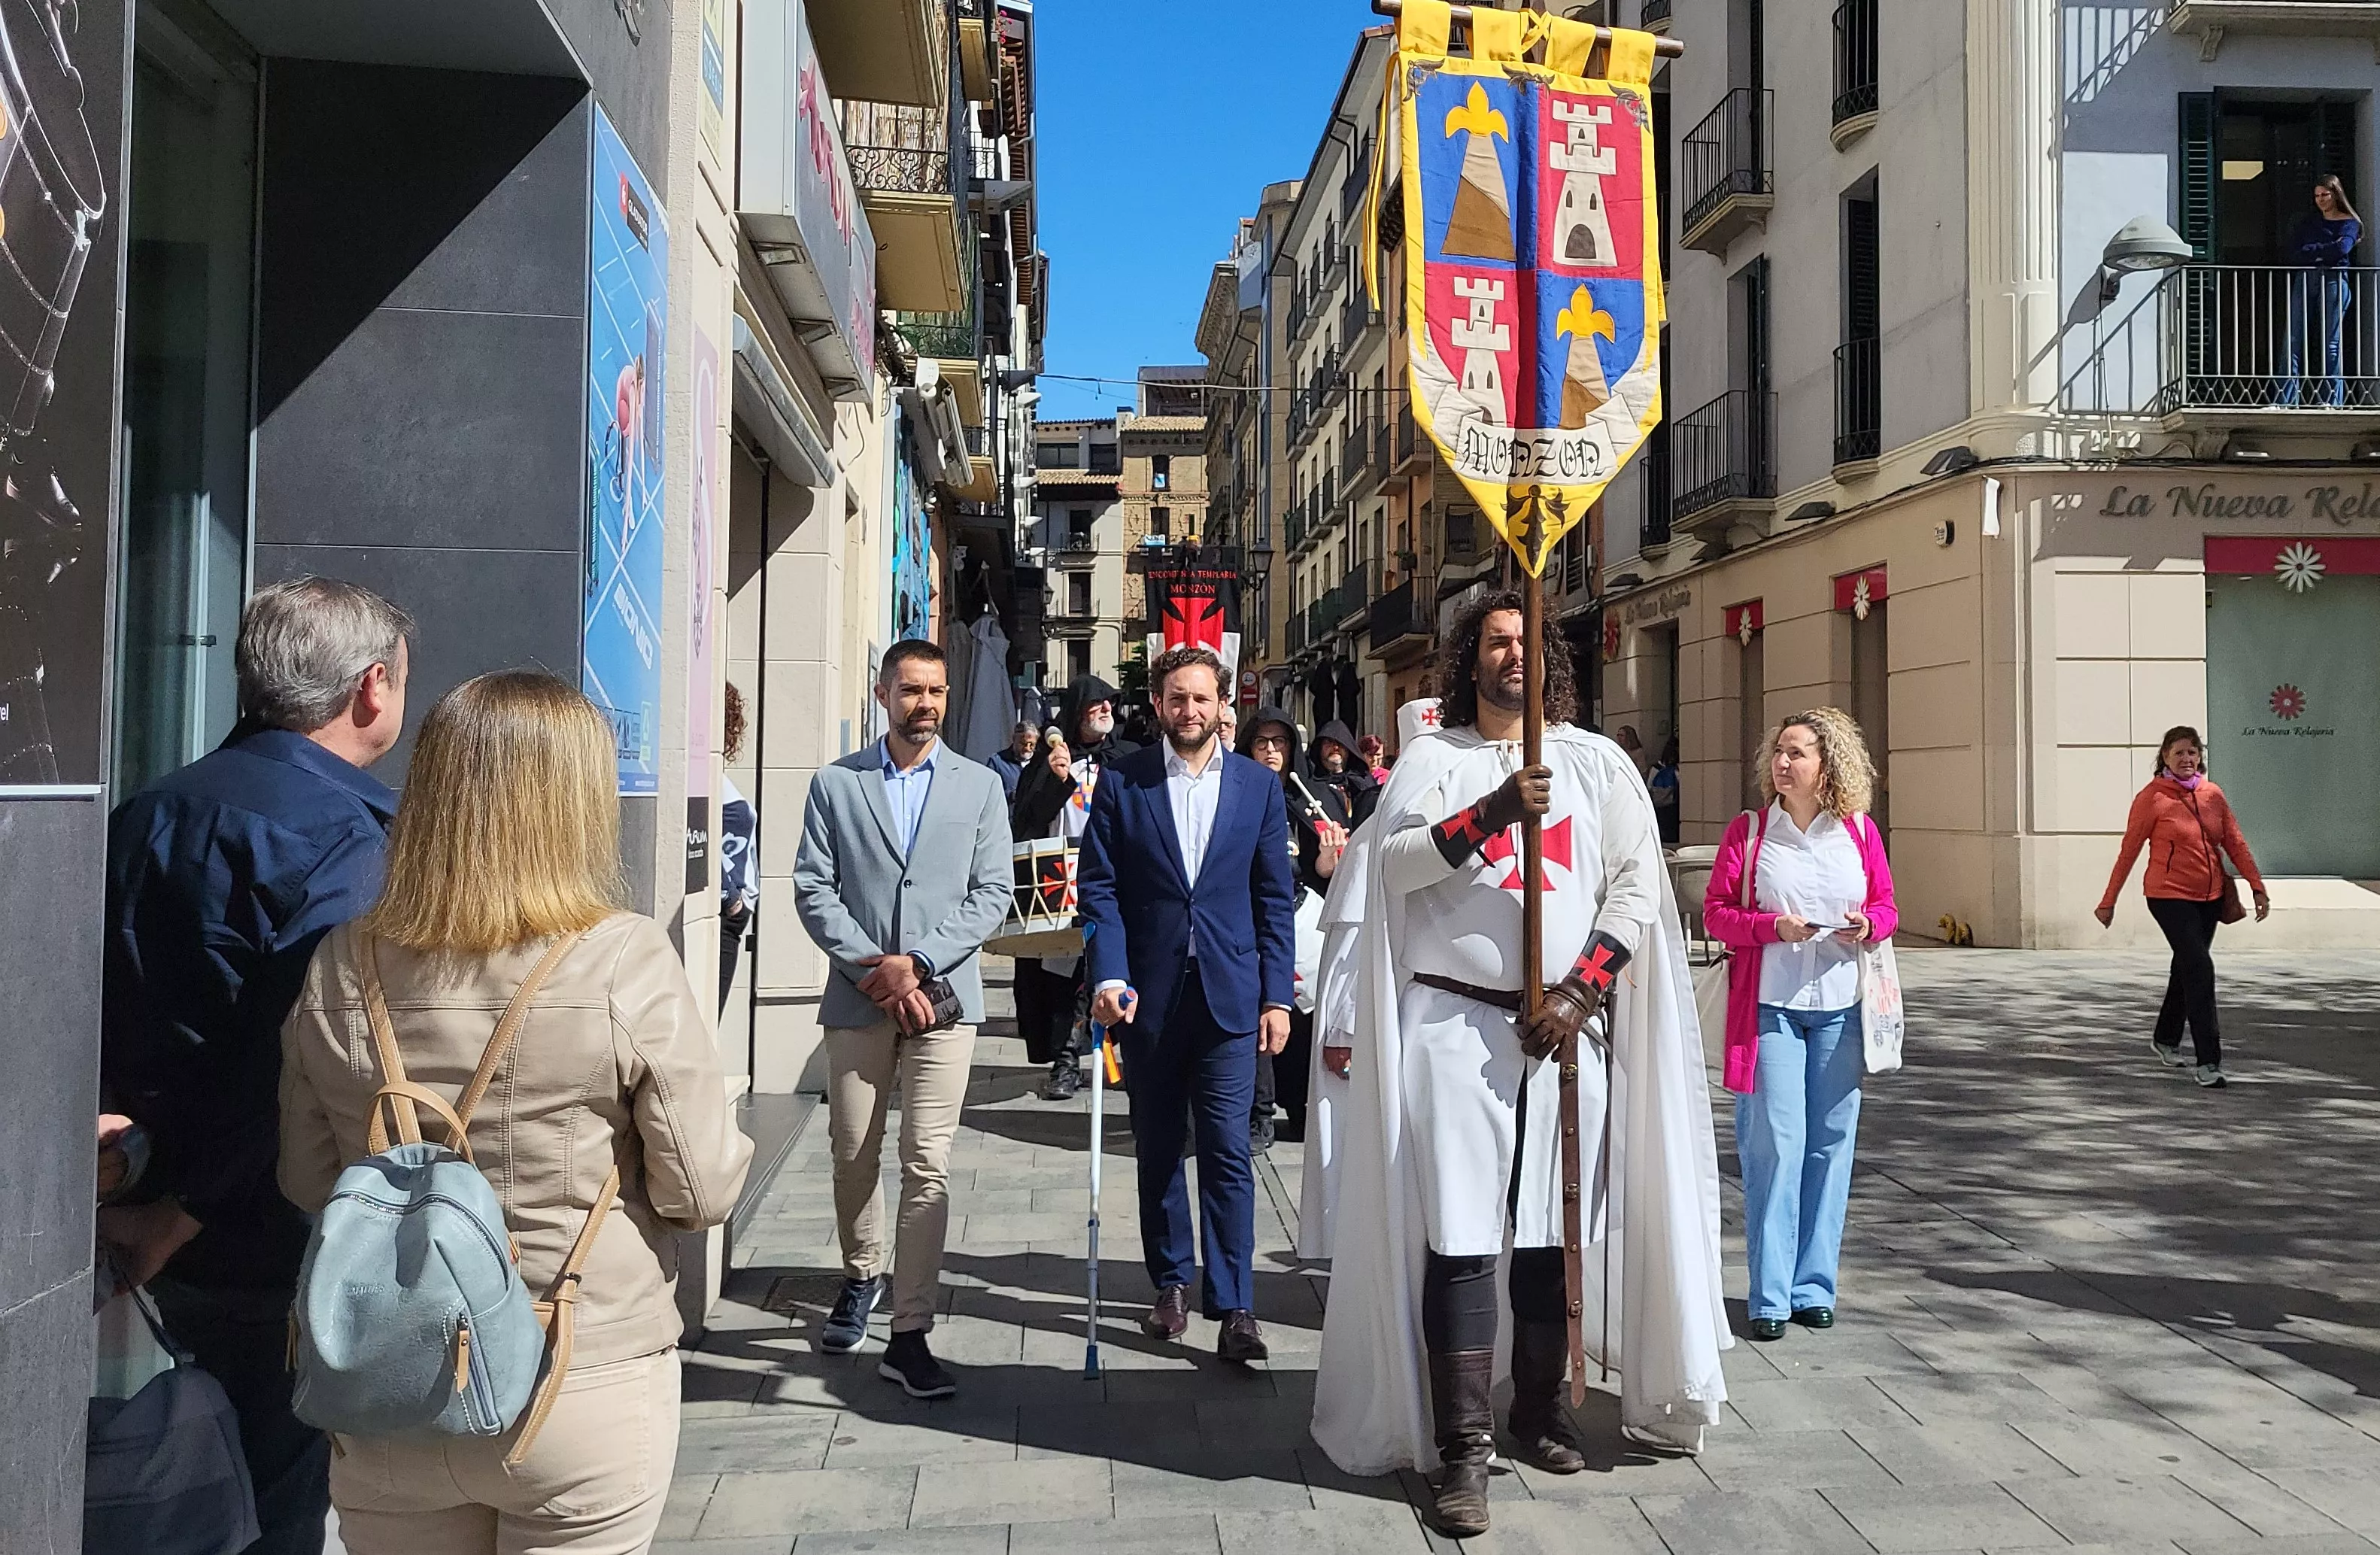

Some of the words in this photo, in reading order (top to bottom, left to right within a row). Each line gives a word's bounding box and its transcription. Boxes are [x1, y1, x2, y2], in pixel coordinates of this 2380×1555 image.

[2100, 485, 2156, 517] La
[2166, 482, 2294, 518] Nueva
[2242, 726, 2255, 736] La
[2258, 726, 2290, 736] Nueva
